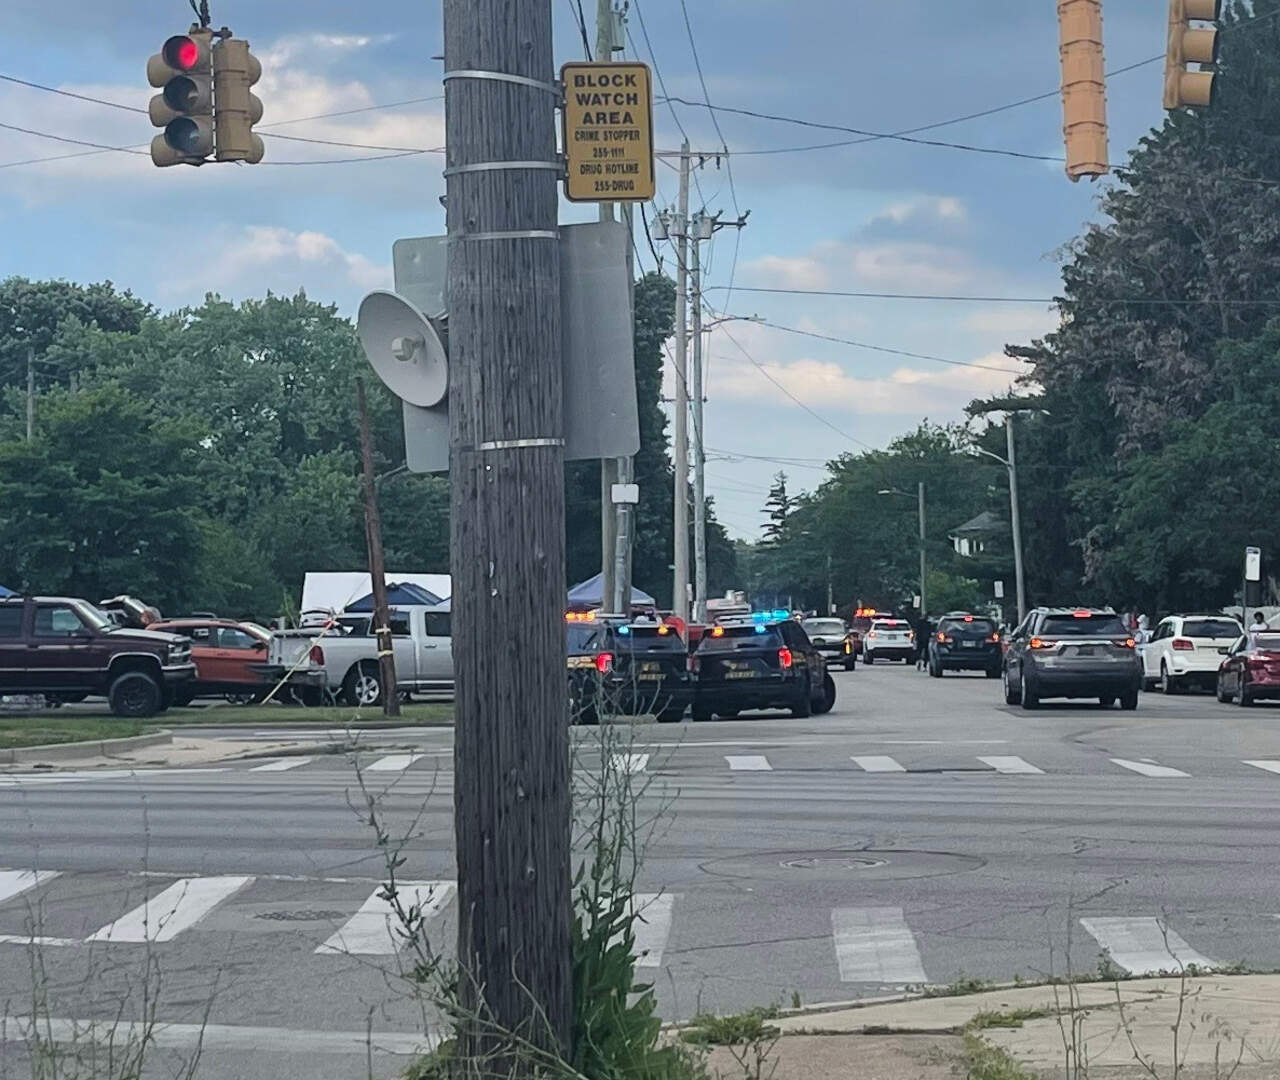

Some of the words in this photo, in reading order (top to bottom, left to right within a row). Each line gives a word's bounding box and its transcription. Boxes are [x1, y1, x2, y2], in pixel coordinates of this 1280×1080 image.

[574, 75, 637, 88] BLOCK
[576, 93, 638, 106] WATCH
[582, 112, 634, 124] AREA
[575, 131, 599, 141] CRIME
[604, 130, 640, 141] STOPPER
[580, 165, 602, 175] DRUG
[605, 163, 639, 174] HOTLINE
[595, 181, 634, 192] 255-DRUG
